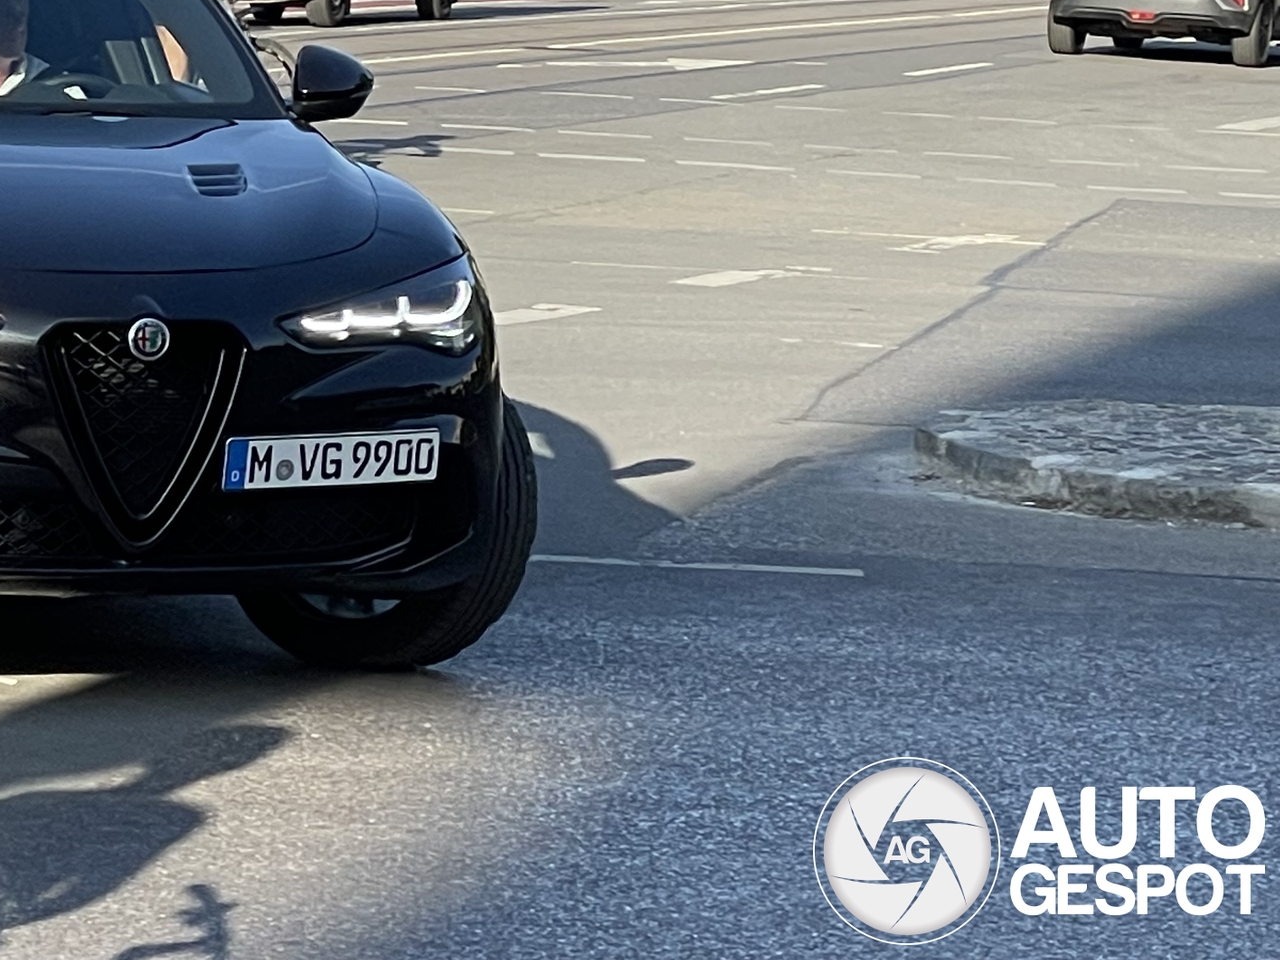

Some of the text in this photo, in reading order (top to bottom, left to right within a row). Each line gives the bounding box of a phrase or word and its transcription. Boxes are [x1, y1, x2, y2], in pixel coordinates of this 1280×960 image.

[248, 437, 435, 483] M VG 9900
[231, 470, 240, 482] D
